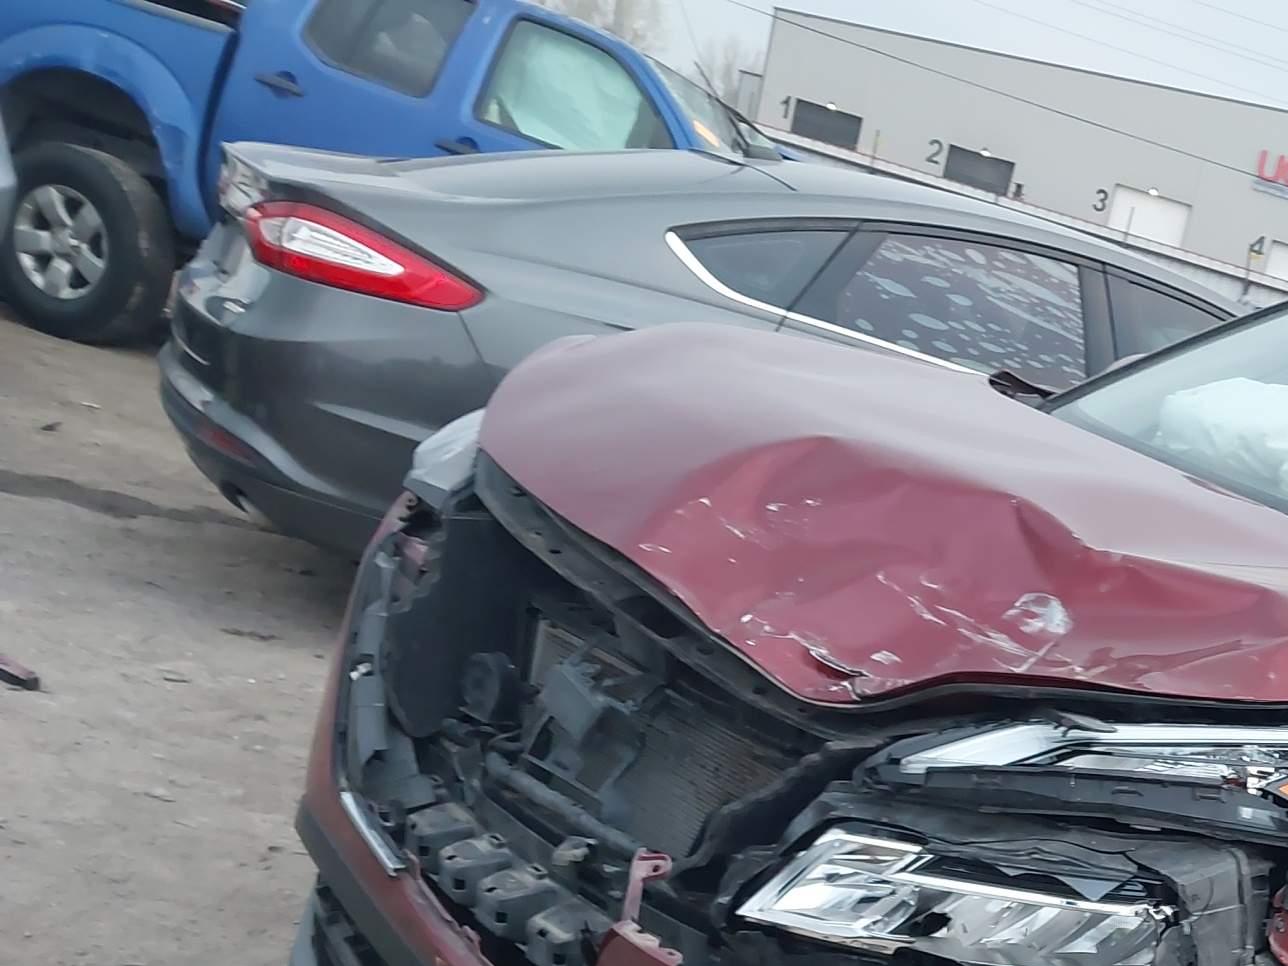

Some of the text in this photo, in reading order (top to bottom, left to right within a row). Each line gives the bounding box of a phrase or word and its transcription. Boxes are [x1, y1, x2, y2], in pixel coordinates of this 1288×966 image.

[780, 95, 792, 119] 1
[925, 139, 944, 165] 2
[1092, 188, 1109, 212] 3
